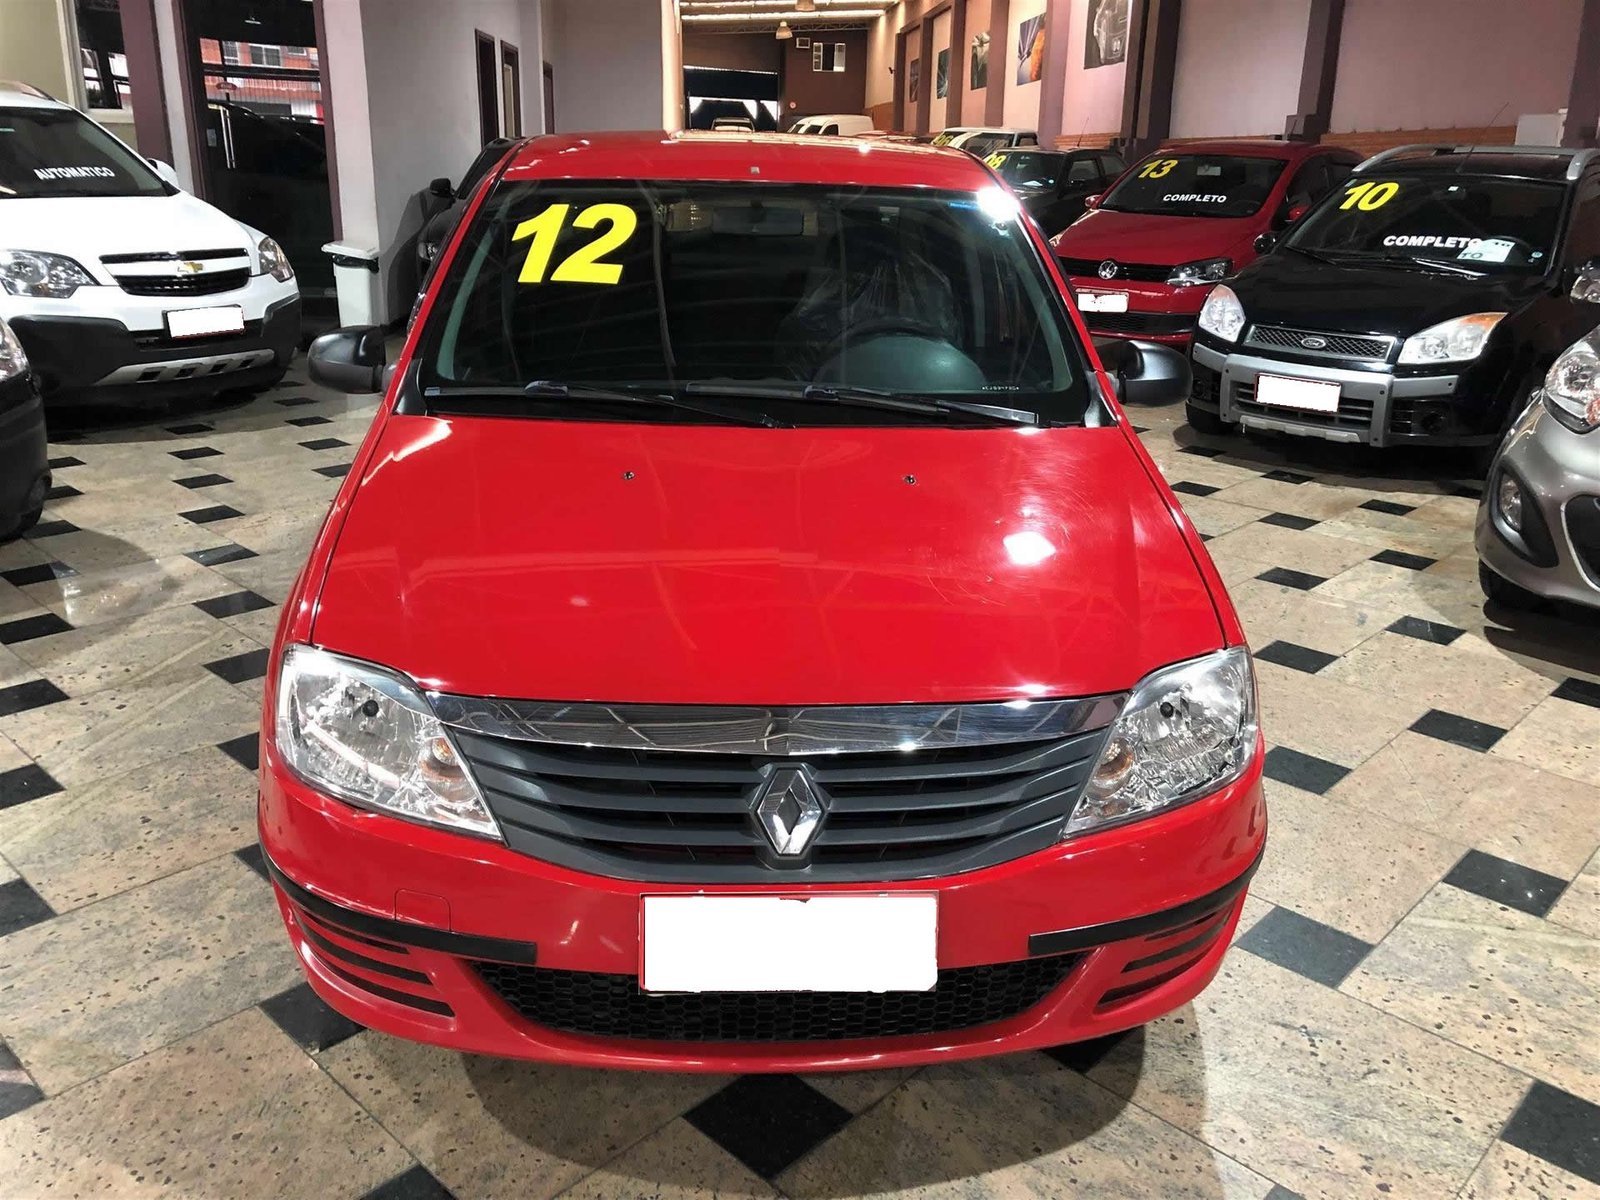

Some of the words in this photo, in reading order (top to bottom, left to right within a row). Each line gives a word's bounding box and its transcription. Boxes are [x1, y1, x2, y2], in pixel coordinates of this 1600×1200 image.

[33, 166, 116, 180] AUTOMATICO
[1138, 159, 1178, 178] 13
[1163, 194, 1227, 203] COMPLETO
[1339, 182, 1399, 211] 10
[511, 203, 637, 284] 12
[1383, 235, 1482, 249] COMPLETO
